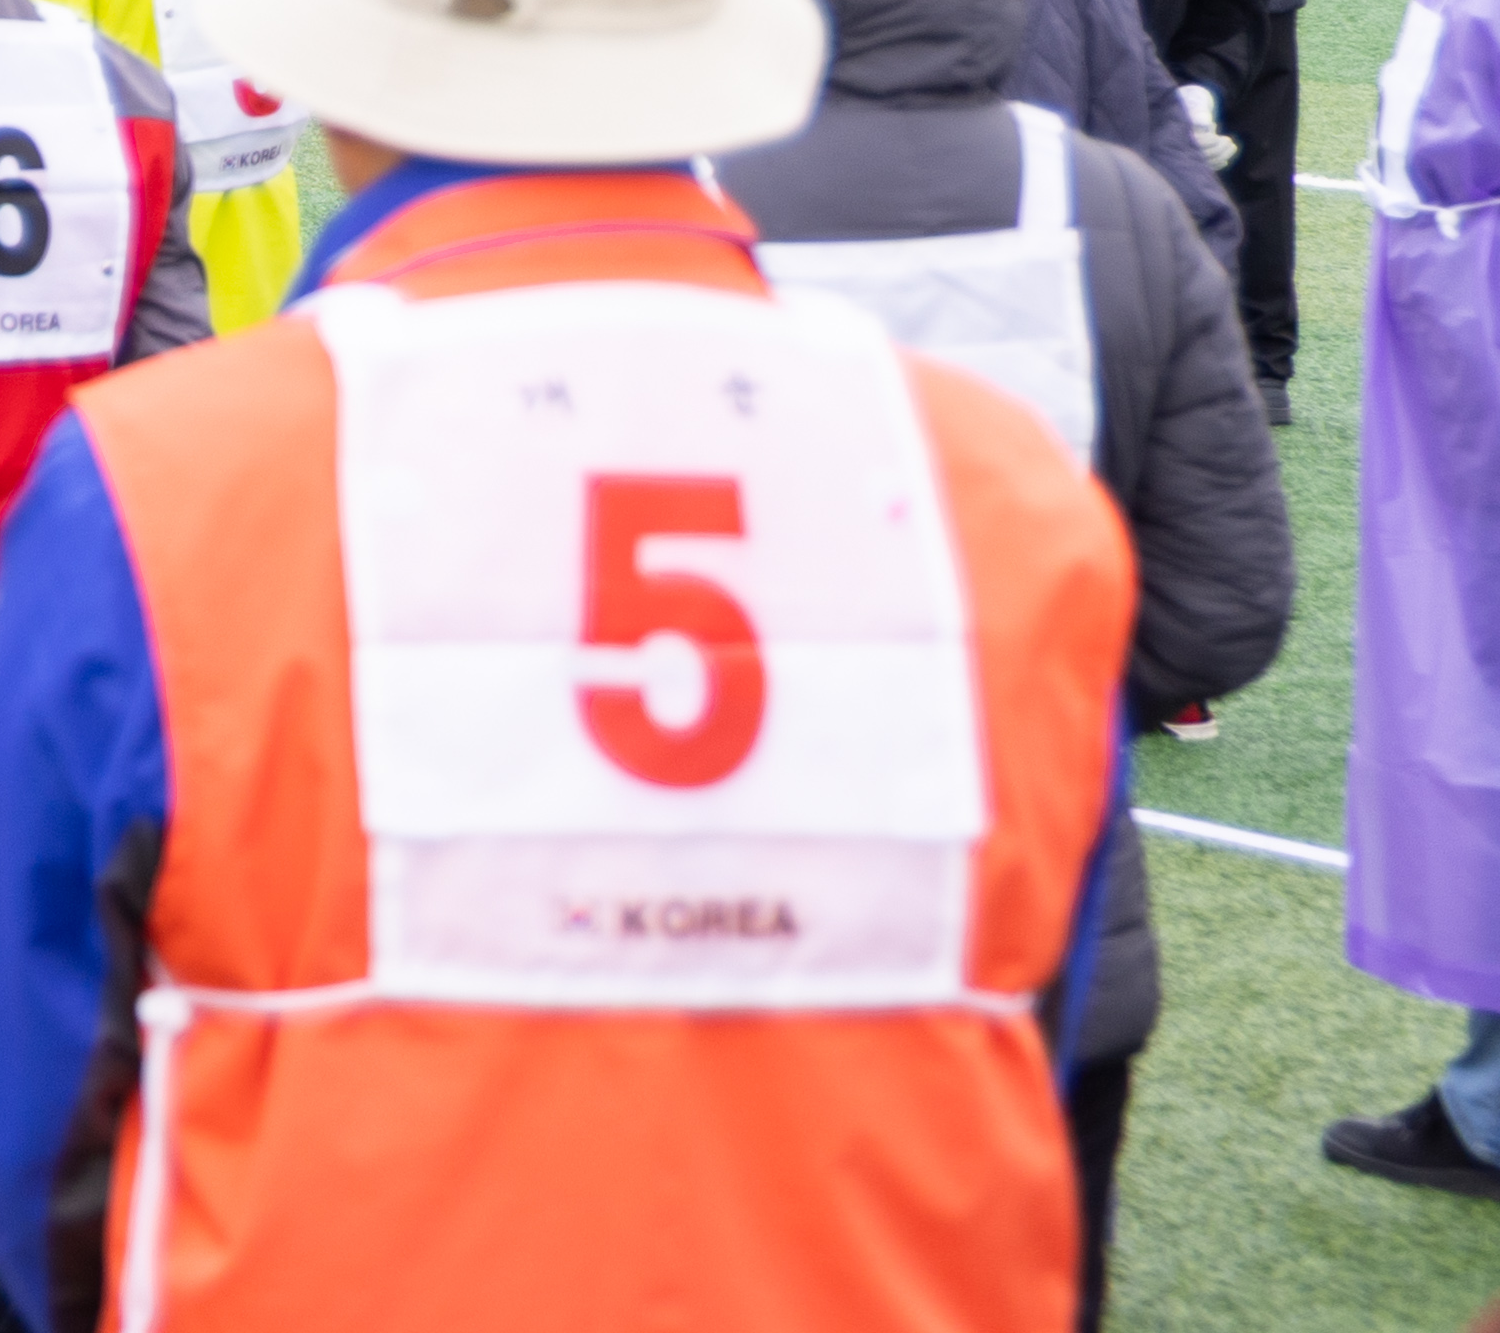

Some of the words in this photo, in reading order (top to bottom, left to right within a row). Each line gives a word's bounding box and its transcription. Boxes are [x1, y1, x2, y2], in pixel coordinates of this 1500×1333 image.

[239, 143, 282, 168] KOREA
[574, 472, 767, 789] 5
[621, 899, 798, 940] KOREA
